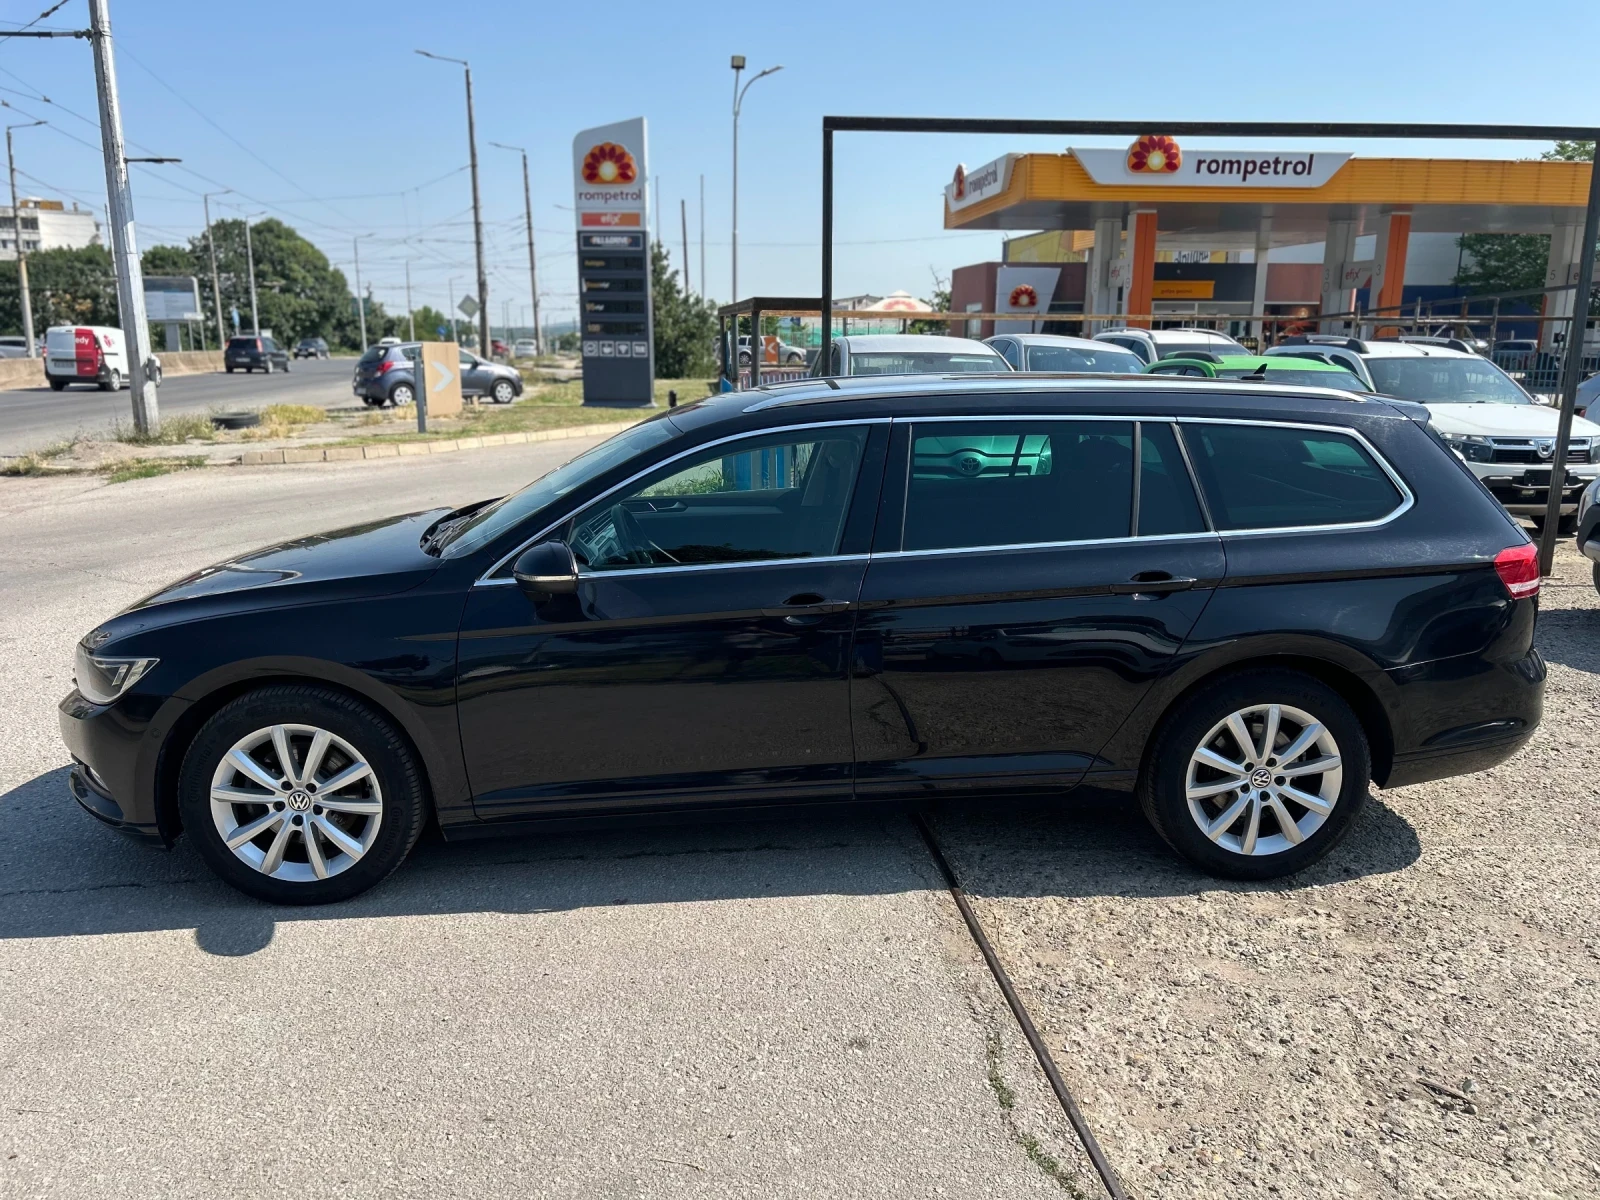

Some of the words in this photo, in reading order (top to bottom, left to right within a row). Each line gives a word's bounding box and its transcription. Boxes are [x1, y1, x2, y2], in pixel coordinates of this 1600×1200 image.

[968, 161, 998, 196] rompetrol
[1195, 153, 1315, 182] rompetrol
[578, 188, 642, 204] rompetrol
[375, 806, 403, 863] Continental
